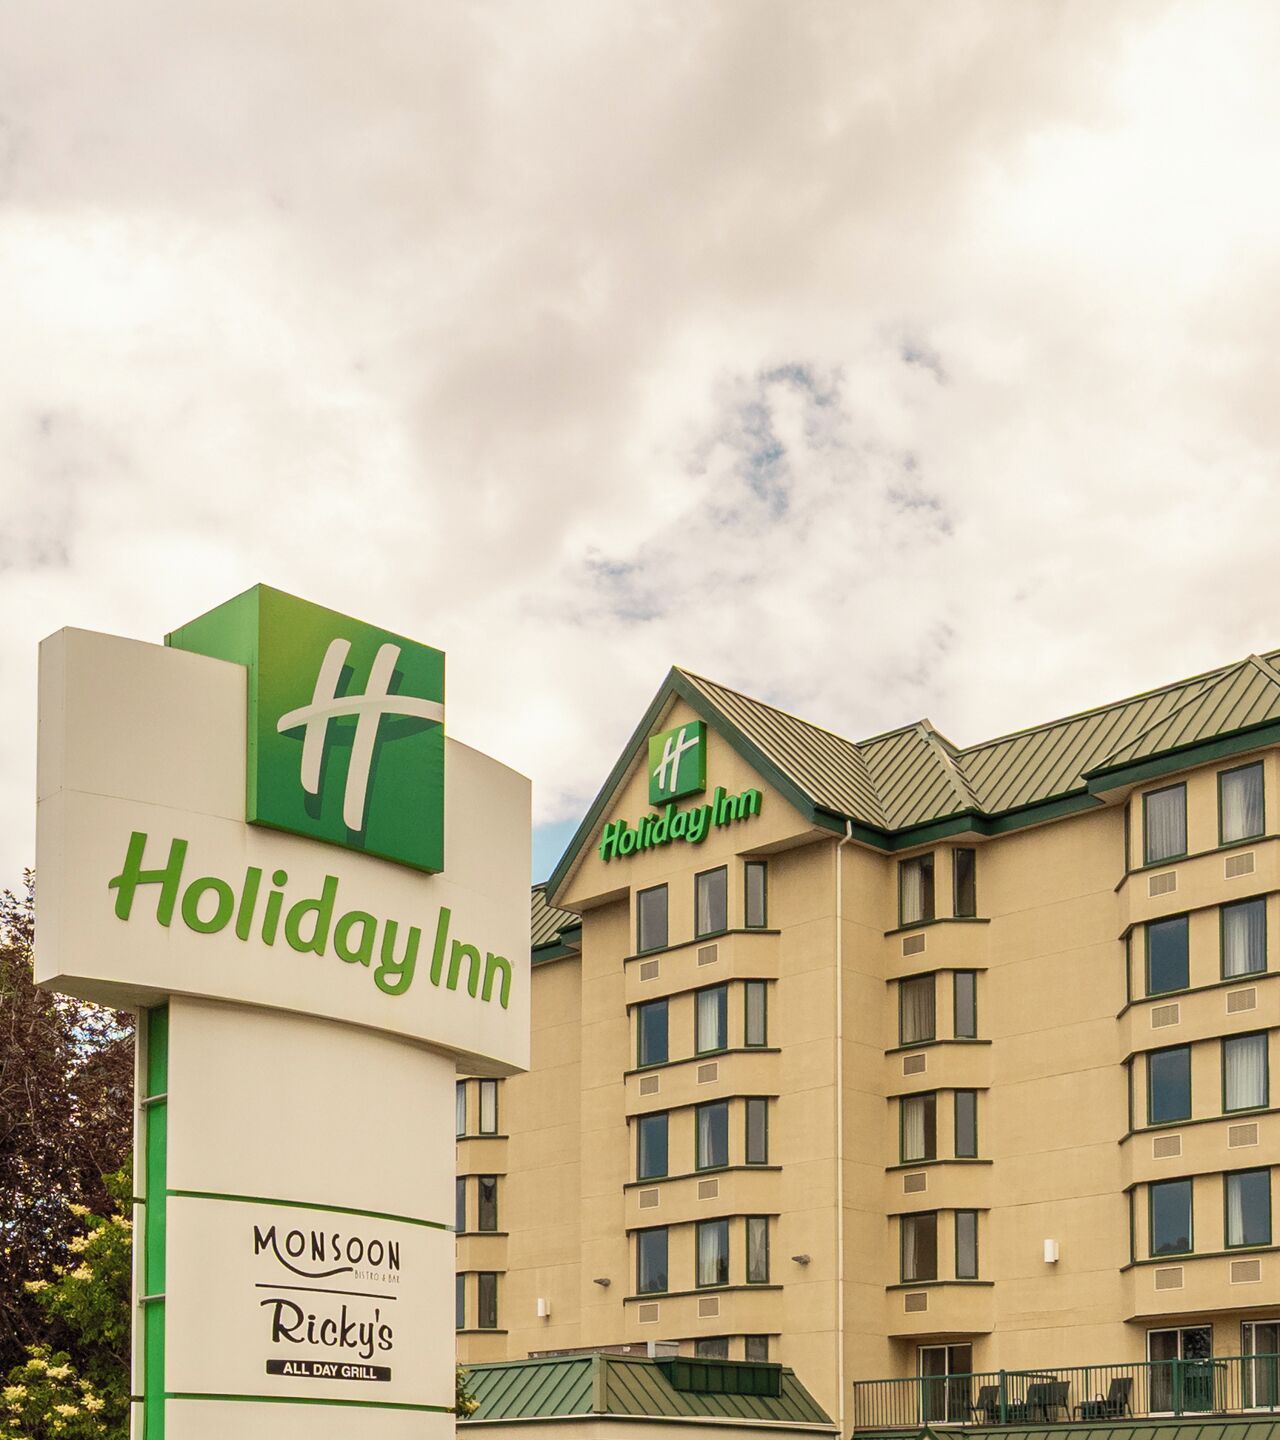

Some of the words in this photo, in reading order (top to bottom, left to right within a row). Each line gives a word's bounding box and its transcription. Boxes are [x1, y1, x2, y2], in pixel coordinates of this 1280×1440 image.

[598, 802, 712, 861] Holiday
[711, 787, 762, 828] Inn
[108, 831, 421, 996] Holiday
[430, 906, 513, 1010] Inn
[253, 1225, 400, 1278] MONSOON
[260, 1298, 394, 1360] Ricky's
[282, 1361, 310, 1376] ALL
[313, 1363, 339, 1377] DAY
[341, 1365, 377, 1380] GRILL
